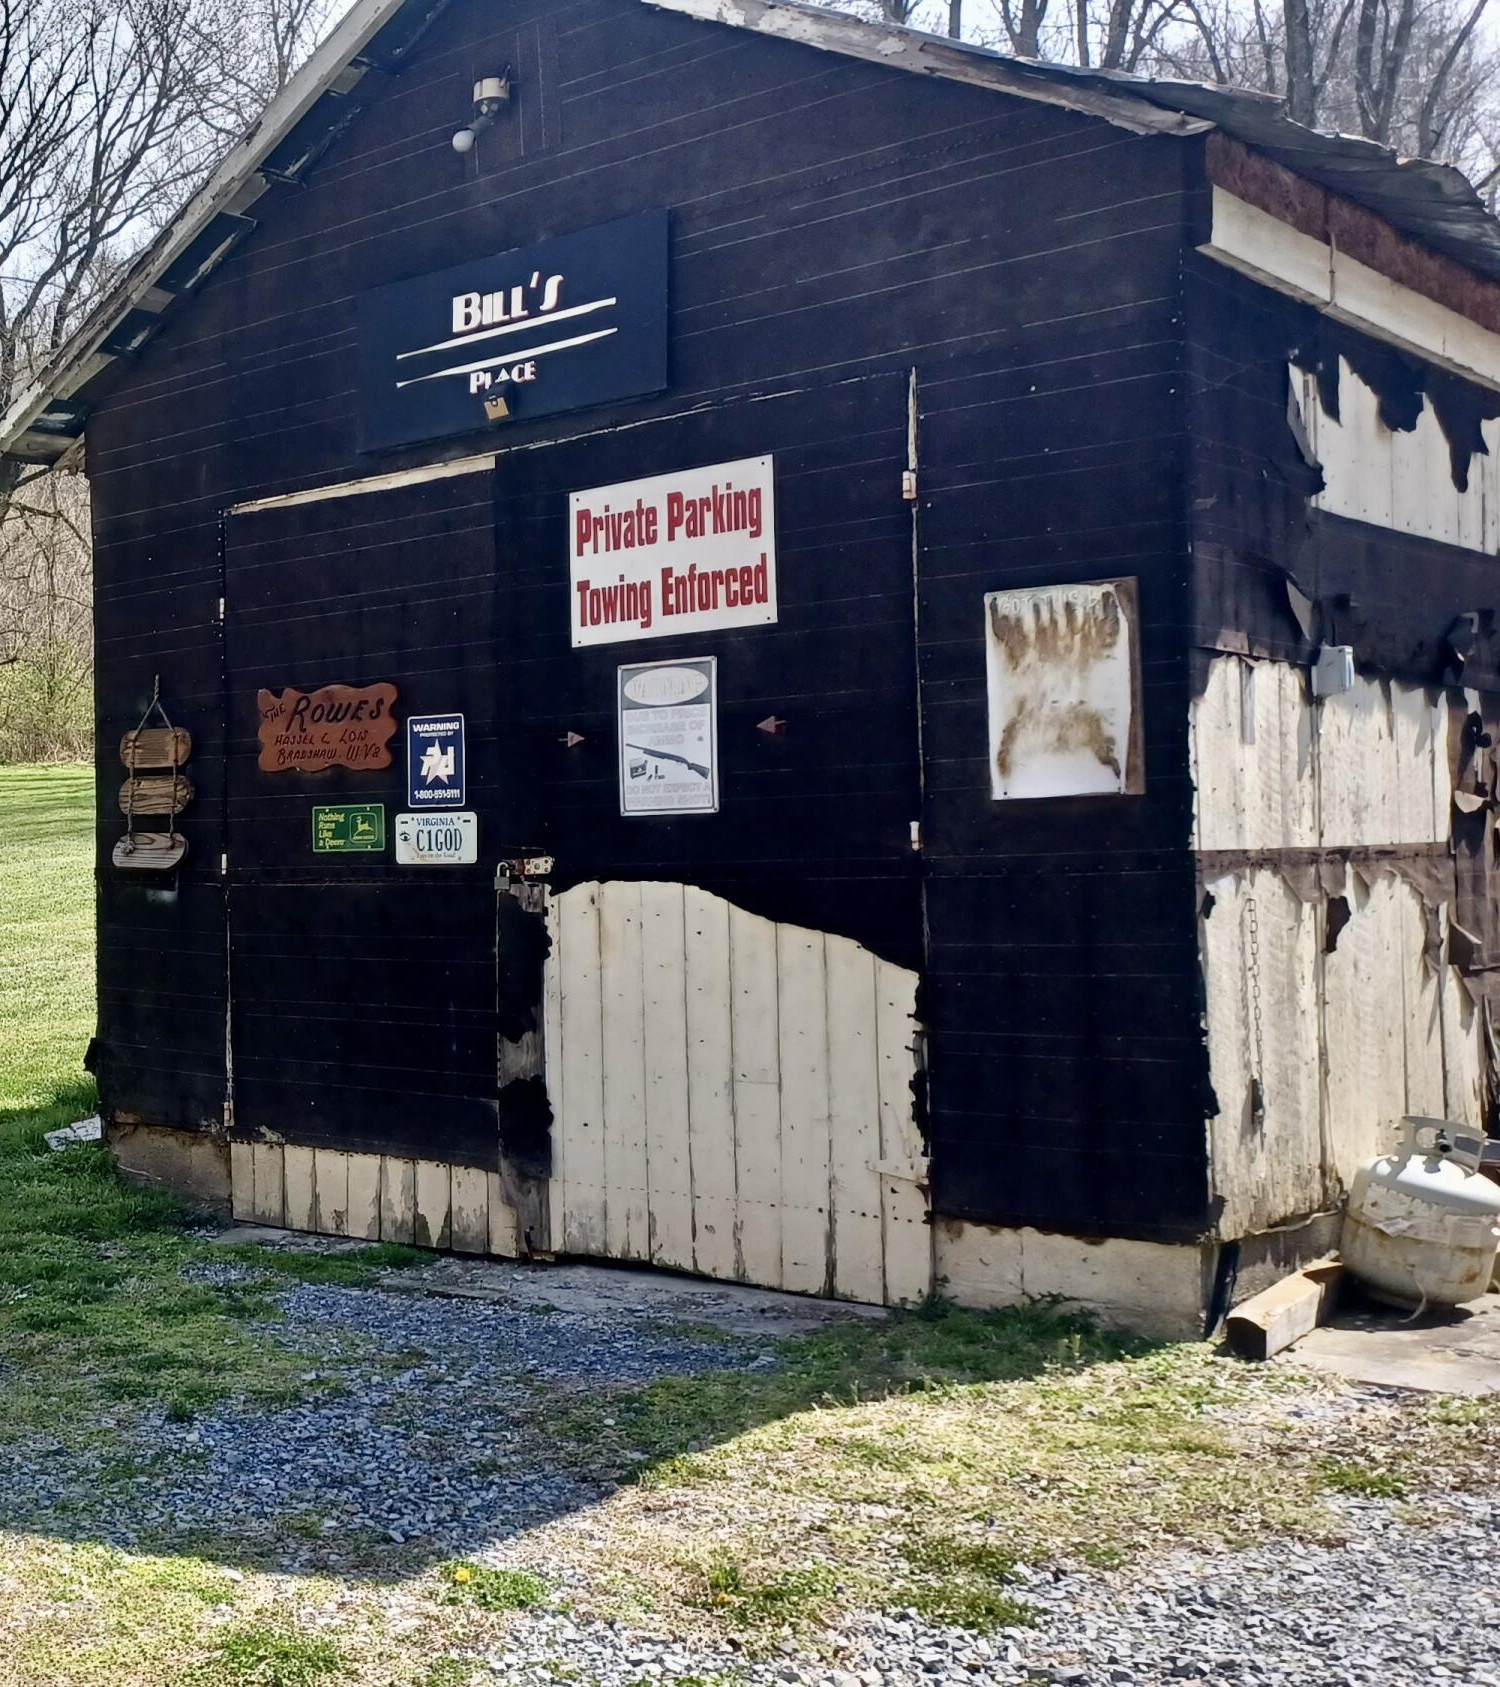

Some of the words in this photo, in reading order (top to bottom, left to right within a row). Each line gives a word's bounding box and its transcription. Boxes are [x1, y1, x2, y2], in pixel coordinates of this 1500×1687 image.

[451, 270, 564, 334] BILL'S
[576, 498, 658, 557] Private
[666, 482, 762, 542] Parking
[576, 574, 652, 629] Towing
[661, 552, 768, 617] Enforced
[285, 696, 385, 733] ROWES
[413, 721, 460, 733] WARNING
[339, 728, 369, 745] LOIS
[416, 817, 455, 827] VIRGINIA
